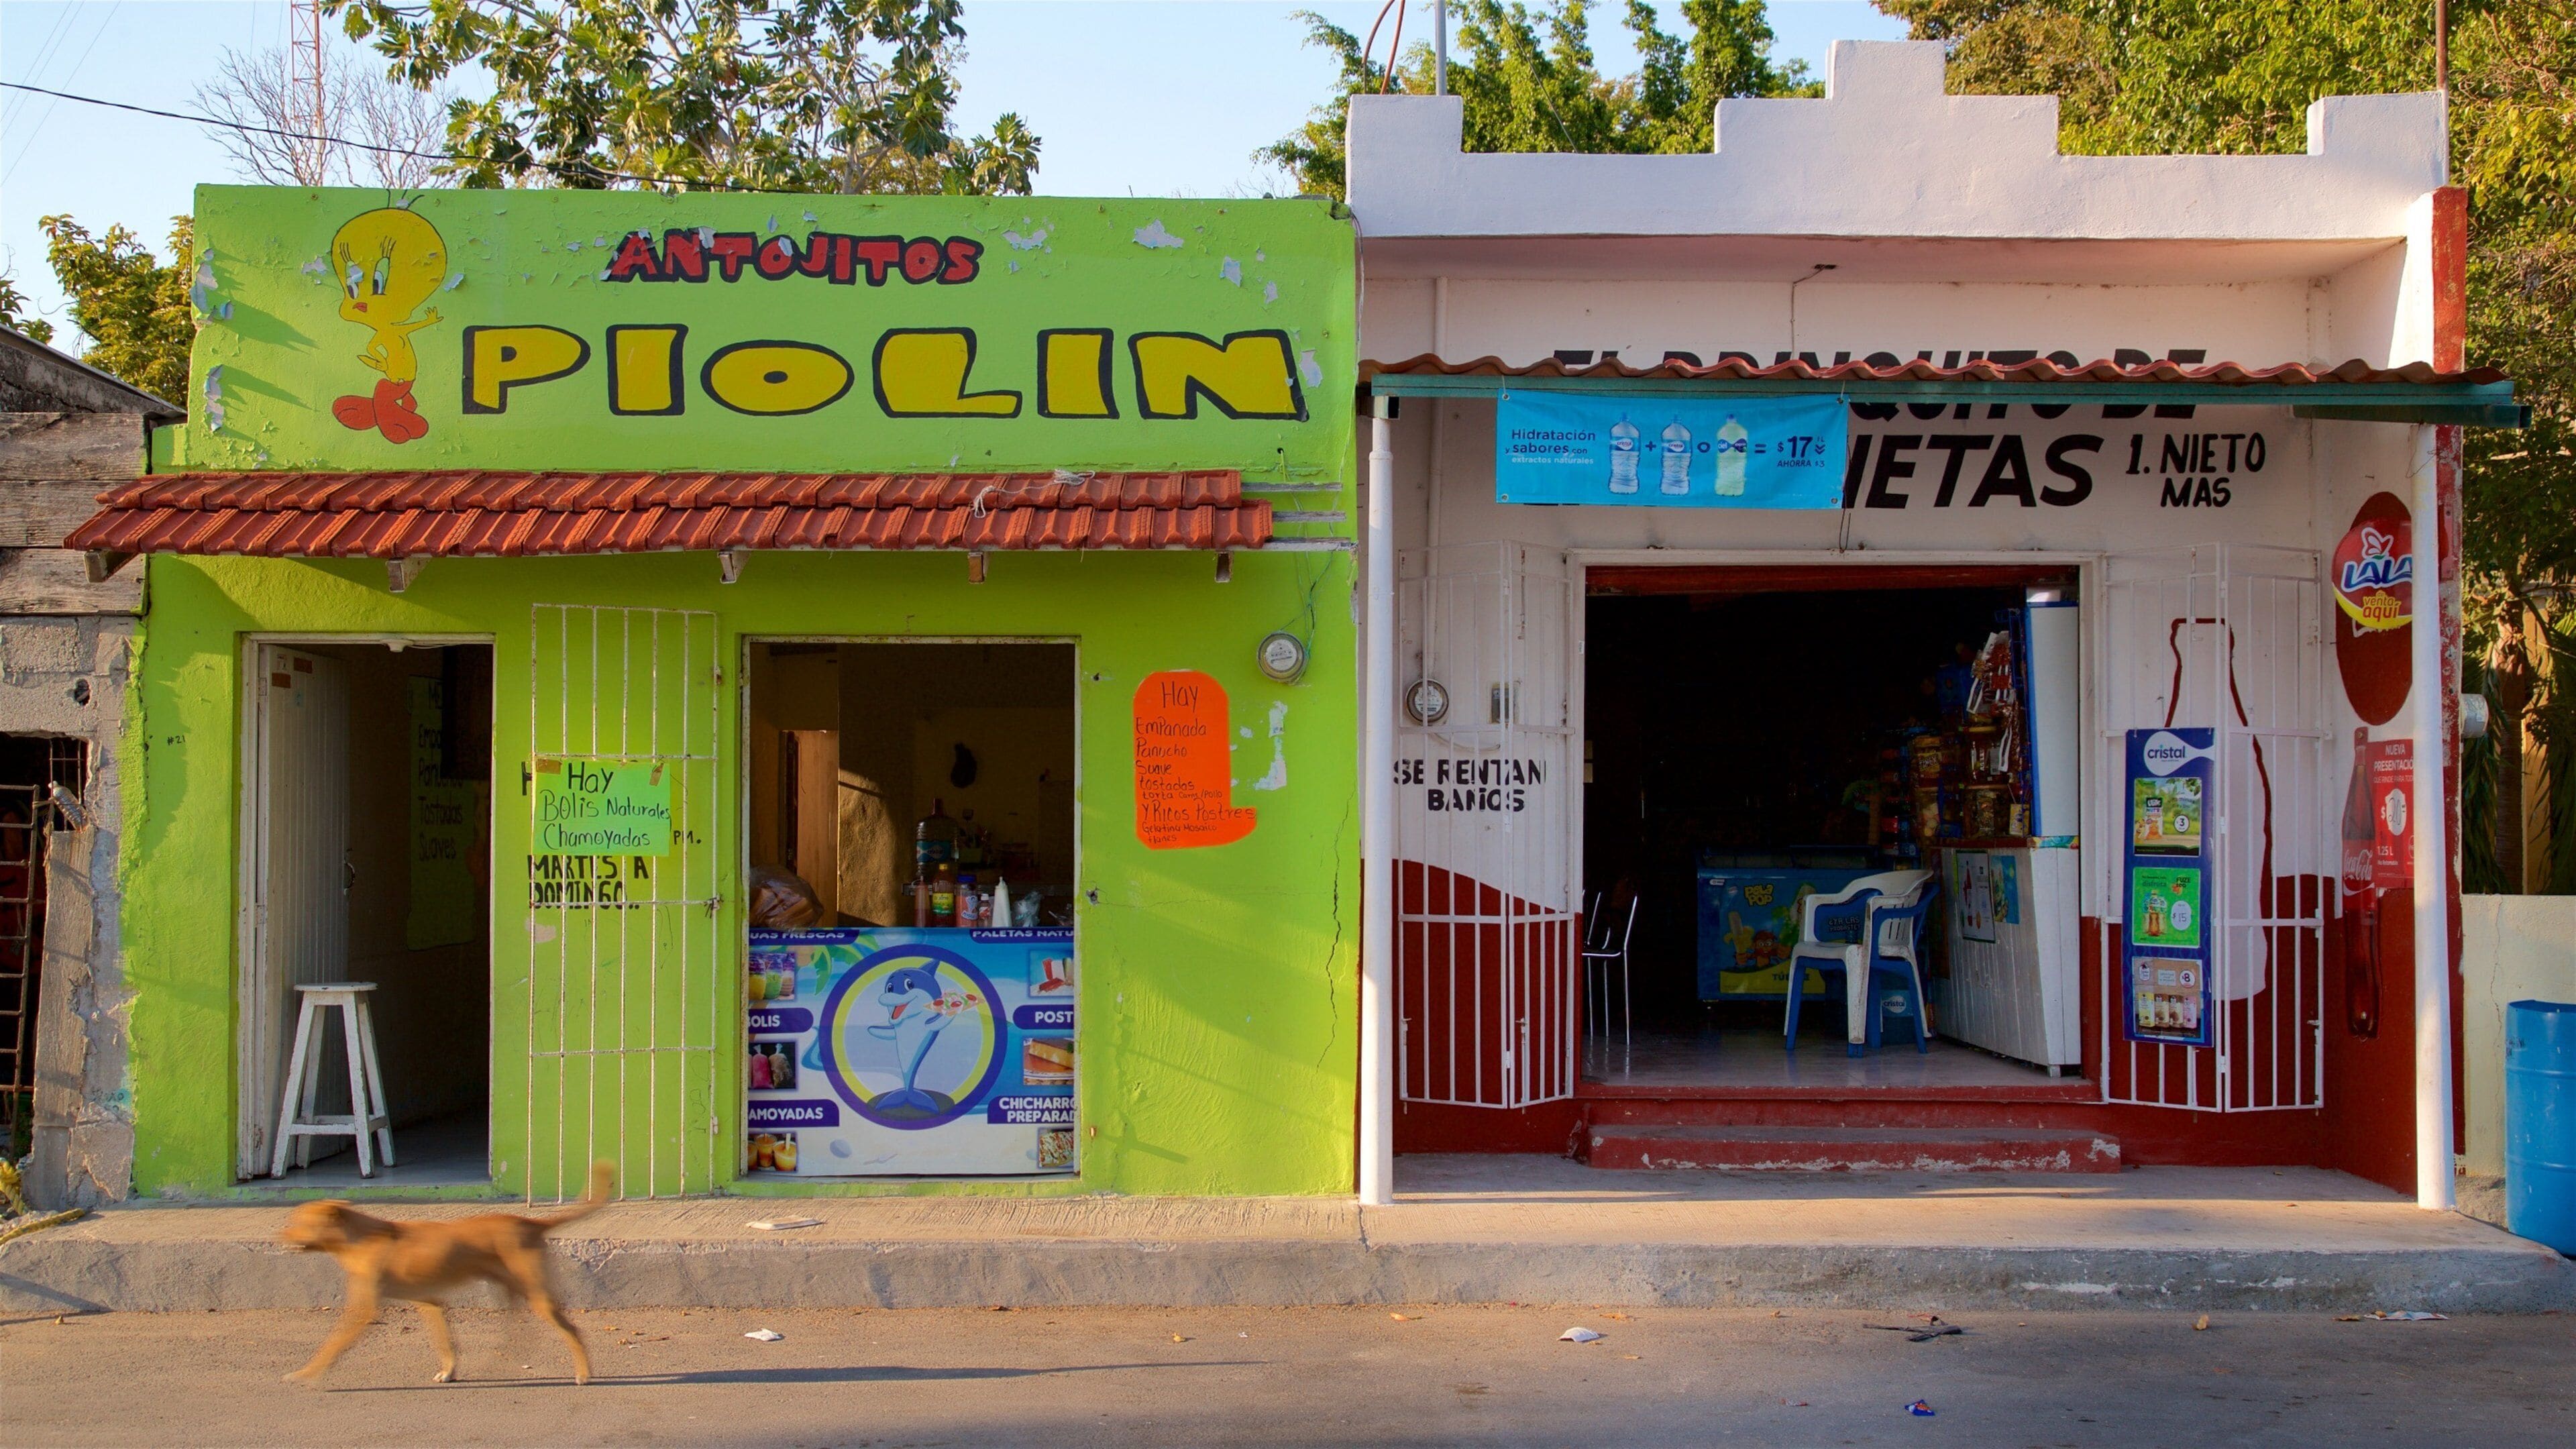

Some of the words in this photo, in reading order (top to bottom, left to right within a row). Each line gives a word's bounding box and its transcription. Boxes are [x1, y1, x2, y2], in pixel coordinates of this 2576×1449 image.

[603, 229, 985, 287] ANTOJITOS
[462, 323, 1310, 421] PIOLIN
[1511, 429, 1596, 441] Hidratación
[1512, 443, 1569, 454] sabores
[2160, 431, 2266, 474] NIETO
[1777, 460, 1812, 468] AHORRA
[2160, 477, 2231, 508] MAS
[2342, 555, 2412, 590] LALA
[2363, 602, 2401, 622] aquí
[2364, 597, 2395, 606] venta
[1162, 680, 1199, 712] Hay
[1136, 737, 1187, 758] Panucho
[2147, 744, 2186, 759] cristal
[2385, 744, 2406, 755] NUEVA
[568, 761, 614, 794] Hay
[1393, 759, 1424, 785] SE
[1438, 759, 1546, 786] RENTAN
[539, 789, 599, 822] Bolis
[606, 796, 671, 820] Naturales
[543, 822, 651, 851] Chamoyadas
[633, 856, 649, 879] A
[1034, 1011, 1074, 1024] POST
[748, 1108, 824, 1120] AMOYADAS
